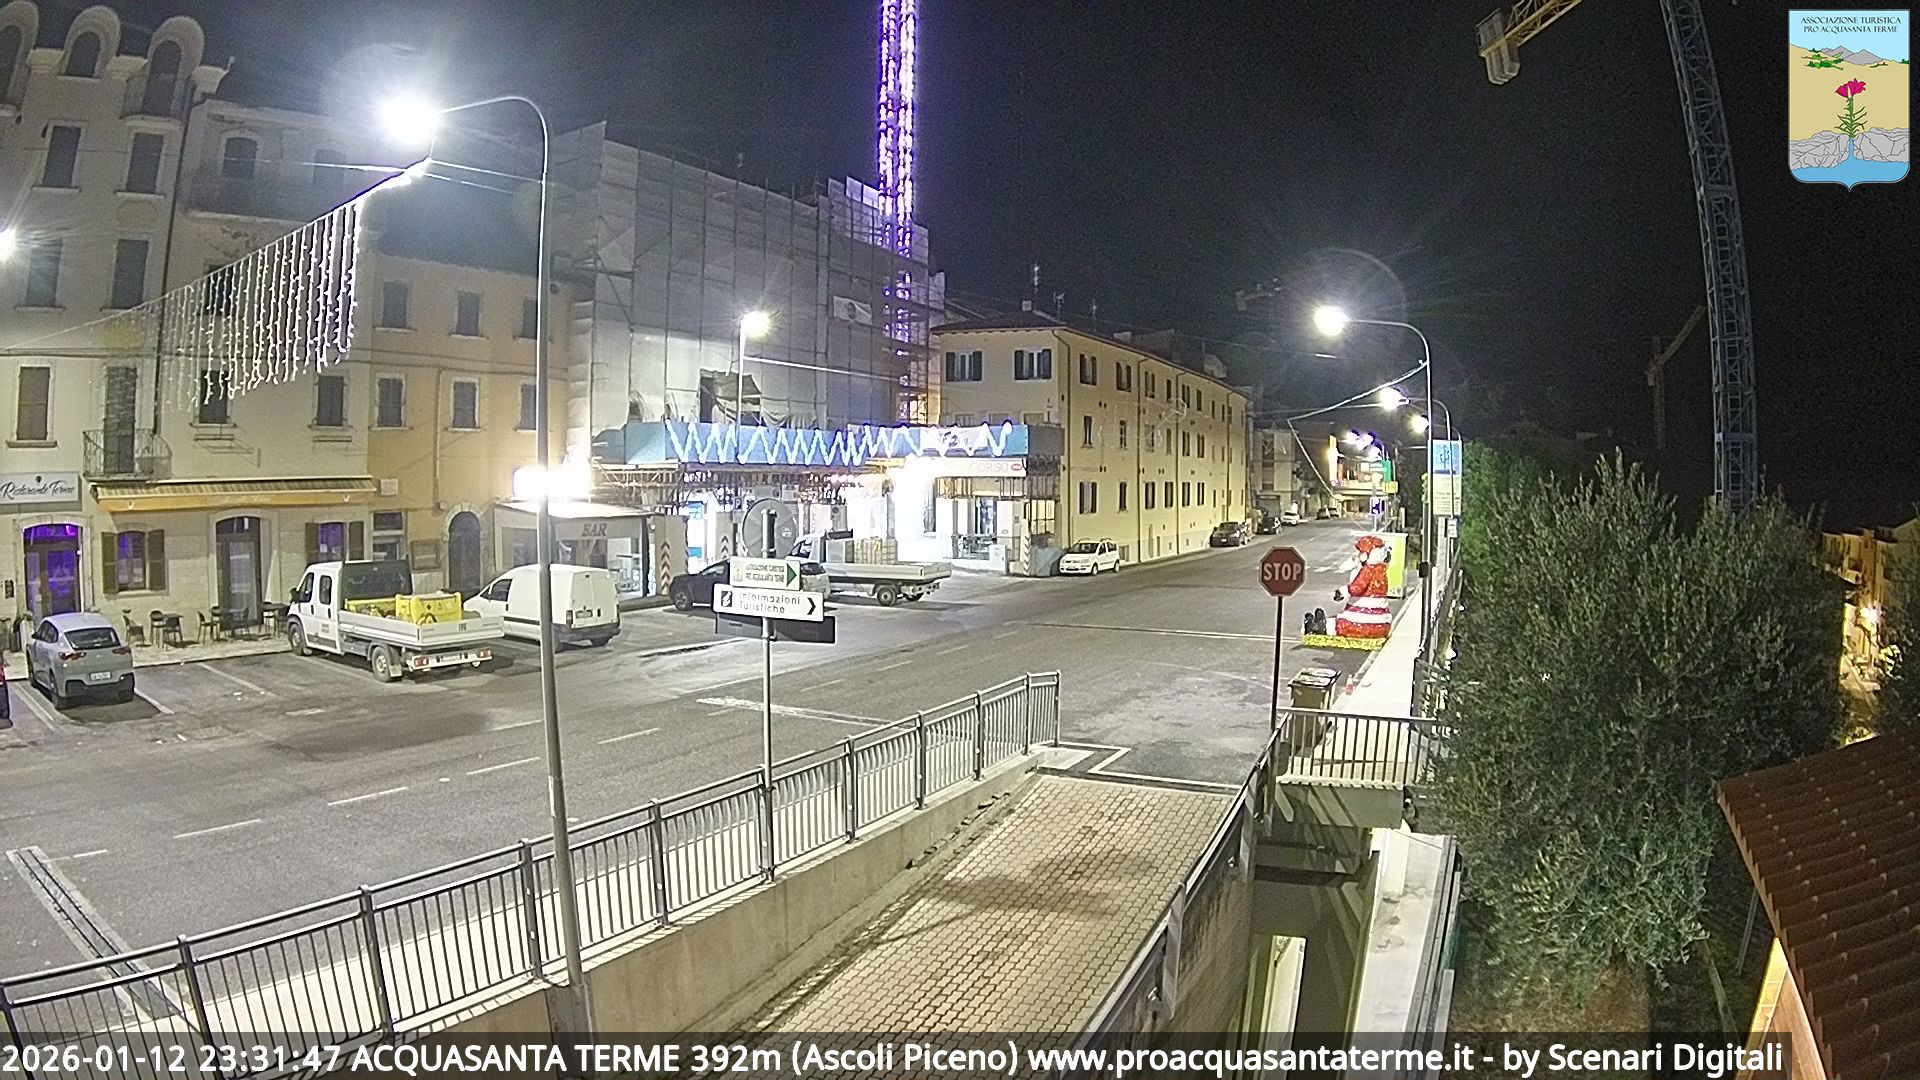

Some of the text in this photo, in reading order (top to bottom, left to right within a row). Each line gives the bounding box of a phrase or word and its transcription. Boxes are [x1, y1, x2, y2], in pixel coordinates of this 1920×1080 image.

[581, 523, 607, 537] BAR
[1263, 562, 1302, 581] STOP
[740, 592, 800, 605] Informazioni
[740, 601, 785, 613] Turistiche
